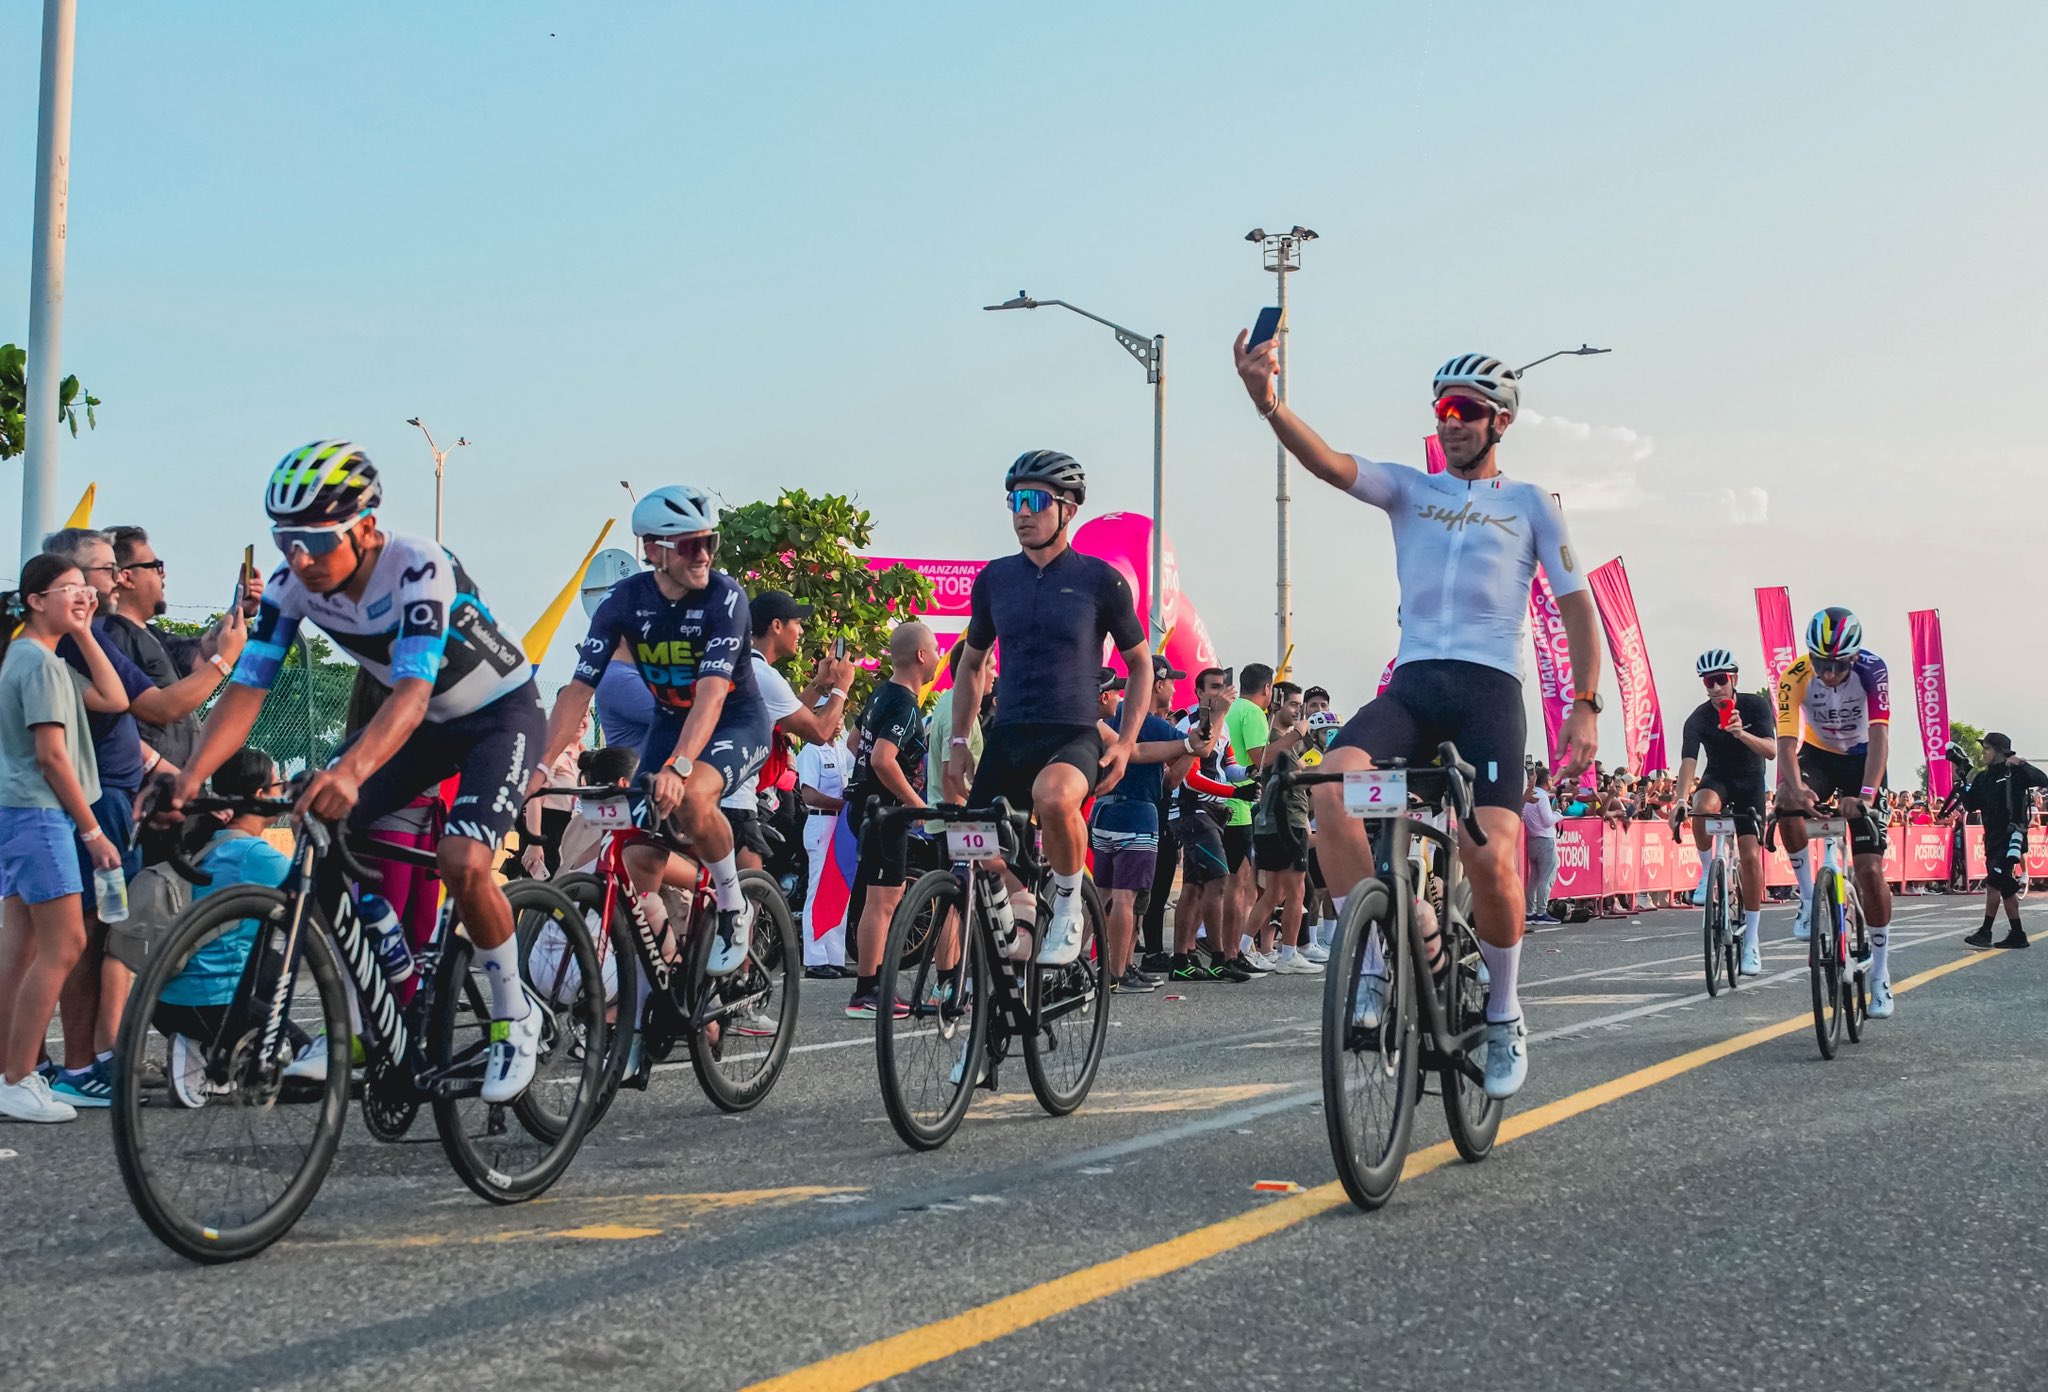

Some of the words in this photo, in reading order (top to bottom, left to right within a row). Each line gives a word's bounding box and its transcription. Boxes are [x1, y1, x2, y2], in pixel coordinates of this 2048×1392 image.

[1418, 502, 1520, 537] SHARK
[918, 565, 976, 576] MANZANA
[680, 625, 702, 637] epm
[1872, 668, 1889, 711] INEOS
[1778, 681, 1792, 723] INEOS
[1813, 706, 1862, 720] INEOS
[1368, 785, 1382, 802] 2
[596, 804, 617, 818] 13
[1716, 821, 1723, 830] 3
[1821, 823, 1830, 831] 4
[962, 834, 985, 848] 10
[333, 891, 408, 1067] CANYON
[258, 971, 292, 1060] CANYON
